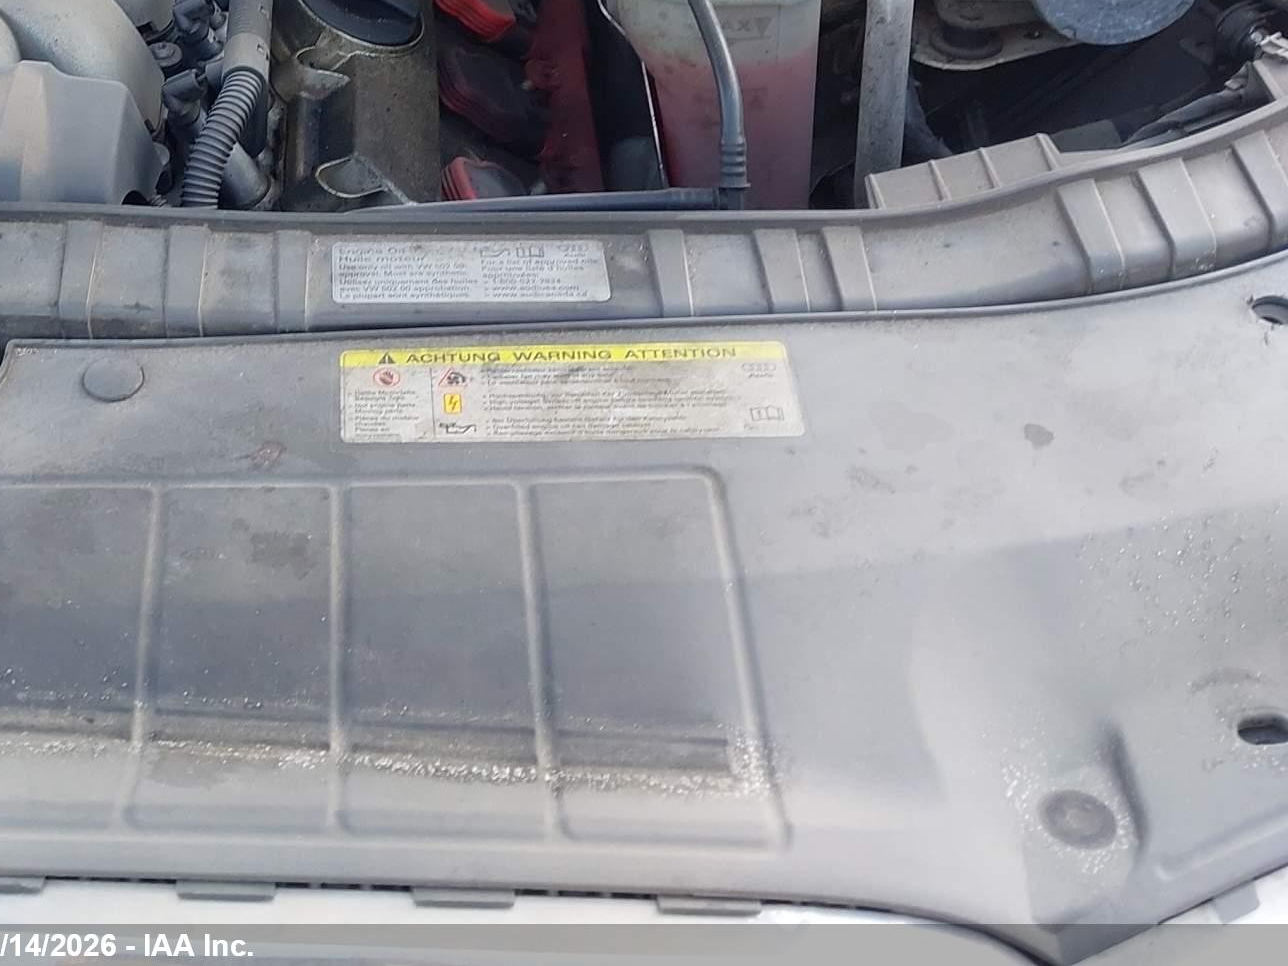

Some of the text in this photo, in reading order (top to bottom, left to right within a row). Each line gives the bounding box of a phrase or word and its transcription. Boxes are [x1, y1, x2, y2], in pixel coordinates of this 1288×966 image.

[405, 347, 737, 364] ACHTUNG WARNING ATTENTION
